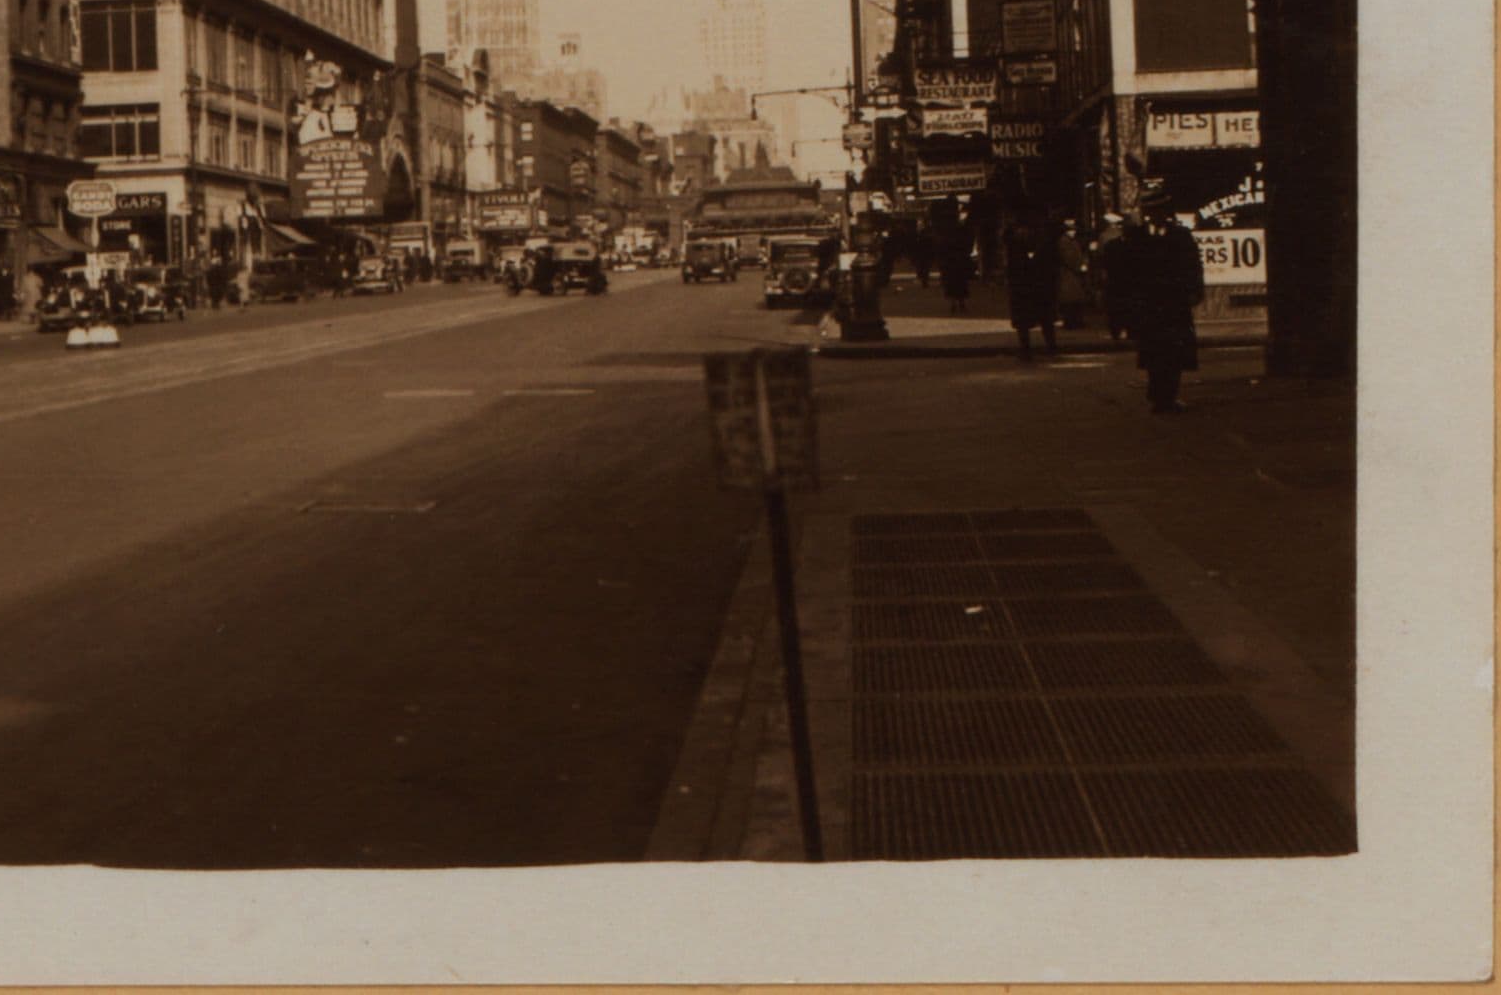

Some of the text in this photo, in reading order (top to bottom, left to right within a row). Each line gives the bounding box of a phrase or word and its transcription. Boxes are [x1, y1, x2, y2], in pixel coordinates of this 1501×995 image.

[920, 87, 991, 98] RESTAURANT
[1153, 113, 1208, 131] PIES
[991, 124, 1043, 139] RADIO
[991, 142, 1043, 157] MUSIC
[1198, 191, 1265, 220] MEXICAN
[1231, 238, 1260, 268] 10
